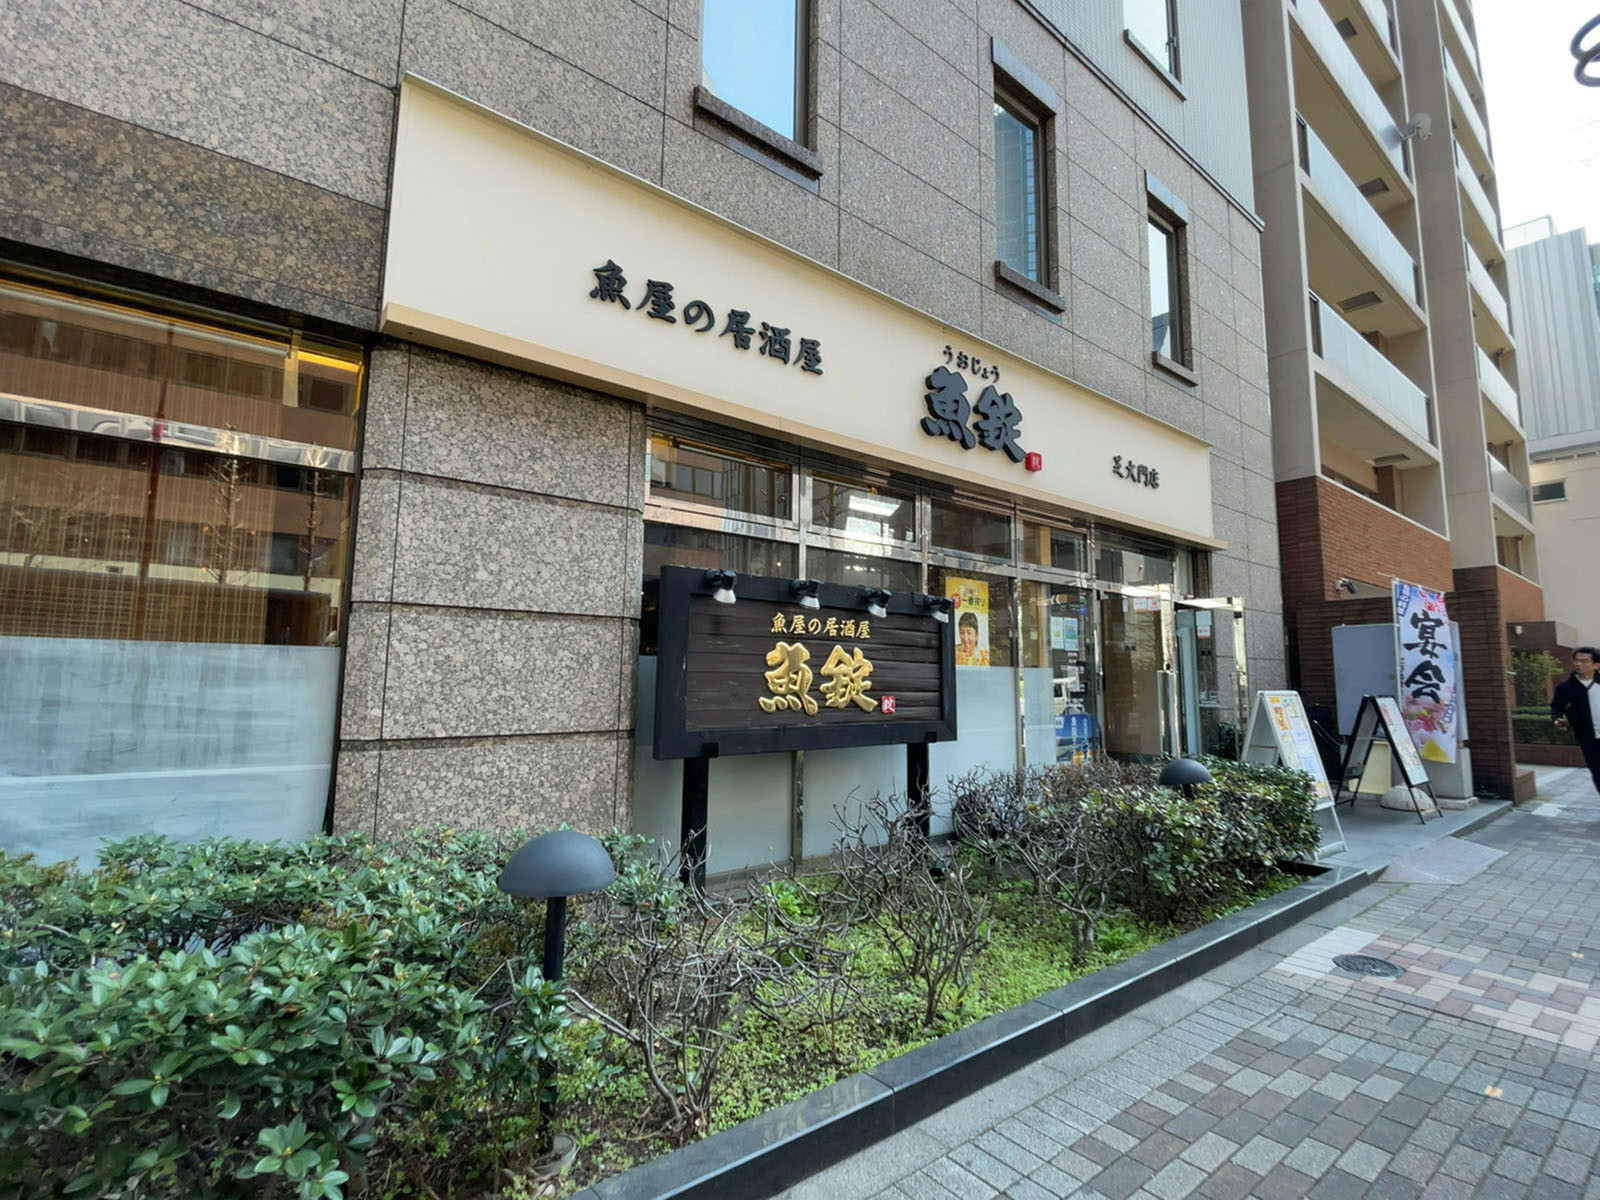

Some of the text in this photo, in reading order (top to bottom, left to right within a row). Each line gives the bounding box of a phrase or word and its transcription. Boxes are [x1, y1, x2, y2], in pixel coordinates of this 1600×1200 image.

[589, 258, 824, 375] 魚屋の居酒屋
[942, 345, 1000, 383] うおじょう
[920, 365, 1027, 463] 魚錠
[1112, 455, 1160, 489] 芝大門店
[770, 612, 871, 639] 魚屋の居酒屋
[1403, 609, 1448, 704] 宴会
[758, 641, 878, 716] 魚錠
